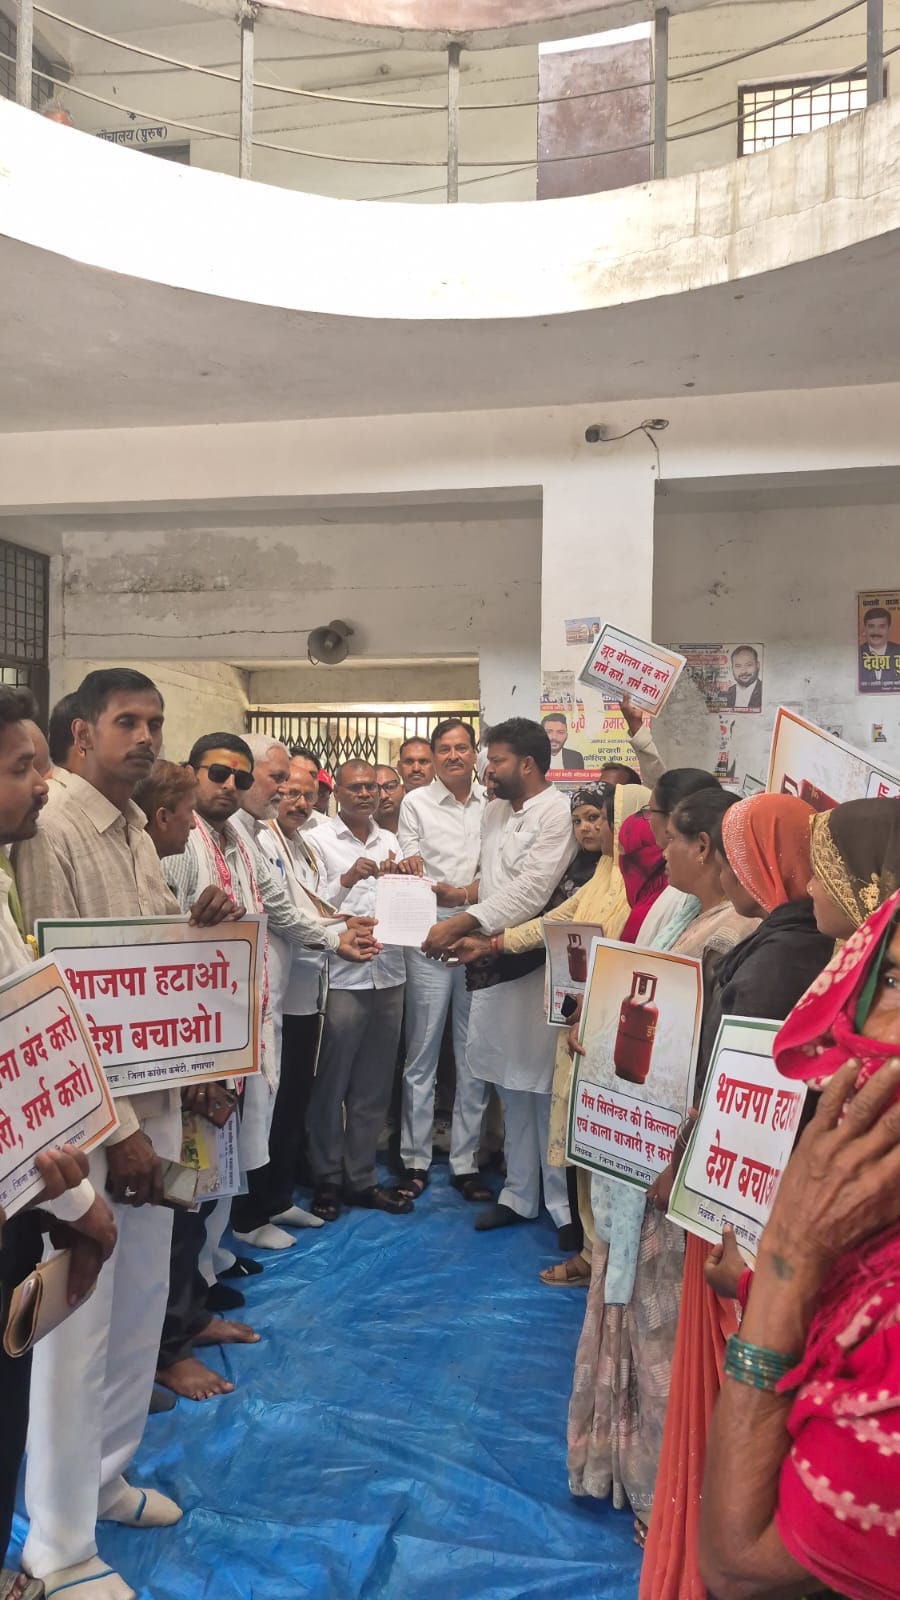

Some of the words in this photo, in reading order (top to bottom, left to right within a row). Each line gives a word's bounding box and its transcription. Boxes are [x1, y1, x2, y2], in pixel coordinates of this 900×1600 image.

[136, 126, 168, 143] (पुरुष)
[593, 660, 610, 675] शर्म
[626, 676, 644, 690] शर्म
[616, 649, 642, 670] बोलना
[641, 661, 654, 677] बंद
[653, 669, 670, 684] करो
[862, 651, 891, 671] देवेश
[64, 966, 147, 1000] भाजपा
[153, 949, 238, 995] हटाओ,
[19, 1025, 49, 1067] बंद
[45, 1005, 77, 1052] करो
[85, 1013, 123, 1057] देश
[129, 1003, 222, 1051] बचाओ।
[21, 1076, 56, 1131] शर्म
[54, 1060, 94, 1108] करो।
[581, 1088, 595, 1110] गैस
[596, 1094, 628, 1122] सिलेन्डर
[630, 1106, 642, 1127] की
[644, 1110, 677, 1139] किल्लत
[716, 1072, 774, 1124] भाजपा
[576, 1114, 589, 1132] एवं
[590, 1121, 612, 1141] काला
[613, 1130, 643, 1153] बाजारी
[644, 1140, 656, 1163] दूर
[705, 1128, 738, 1189] देश
